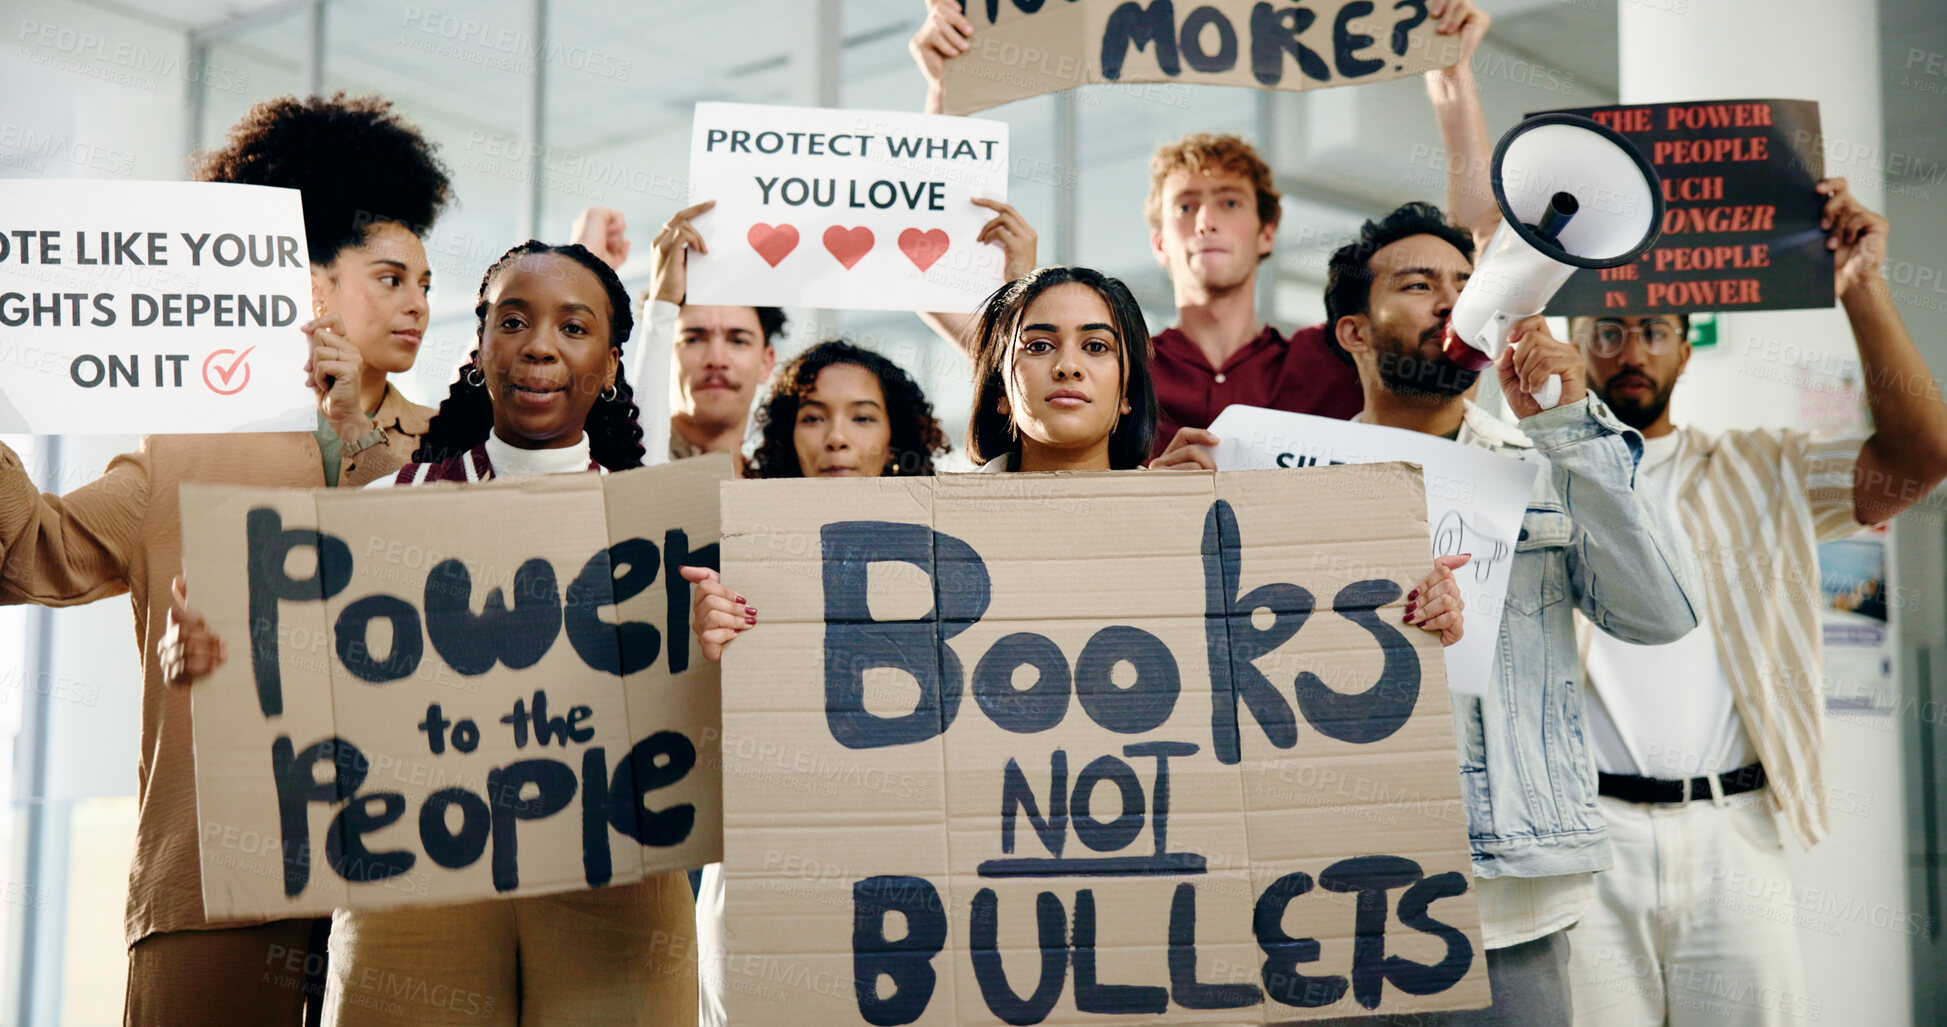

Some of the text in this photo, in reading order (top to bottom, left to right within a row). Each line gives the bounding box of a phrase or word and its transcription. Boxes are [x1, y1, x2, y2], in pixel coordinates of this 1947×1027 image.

[1101, 0, 1428, 85] MORE?
[1667, 103, 1773, 131] POWER
[706, 129, 999, 160] PROTECT WHAT
[1653, 136, 1769, 165] PEOPLE
[754, 176, 946, 211] YOU LOVE
[1661, 176, 1724, 202] UCH
[1661, 205, 1776, 235] ONGER
[76, 231, 169, 266] LIKE
[180, 232, 304, 269] YOUR
[1654, 243, 1771, 272] PEOPLE
[1646, 278, 1762, 307] POWER
[130, 293, 298, 328] DEPEND
[70, 353, 190, 389] ON IT
[418, 688, 595, 755] to the
[1000, 740, 1201, 858] NOT
[851, 854, 1474, 1027] BULLETS
